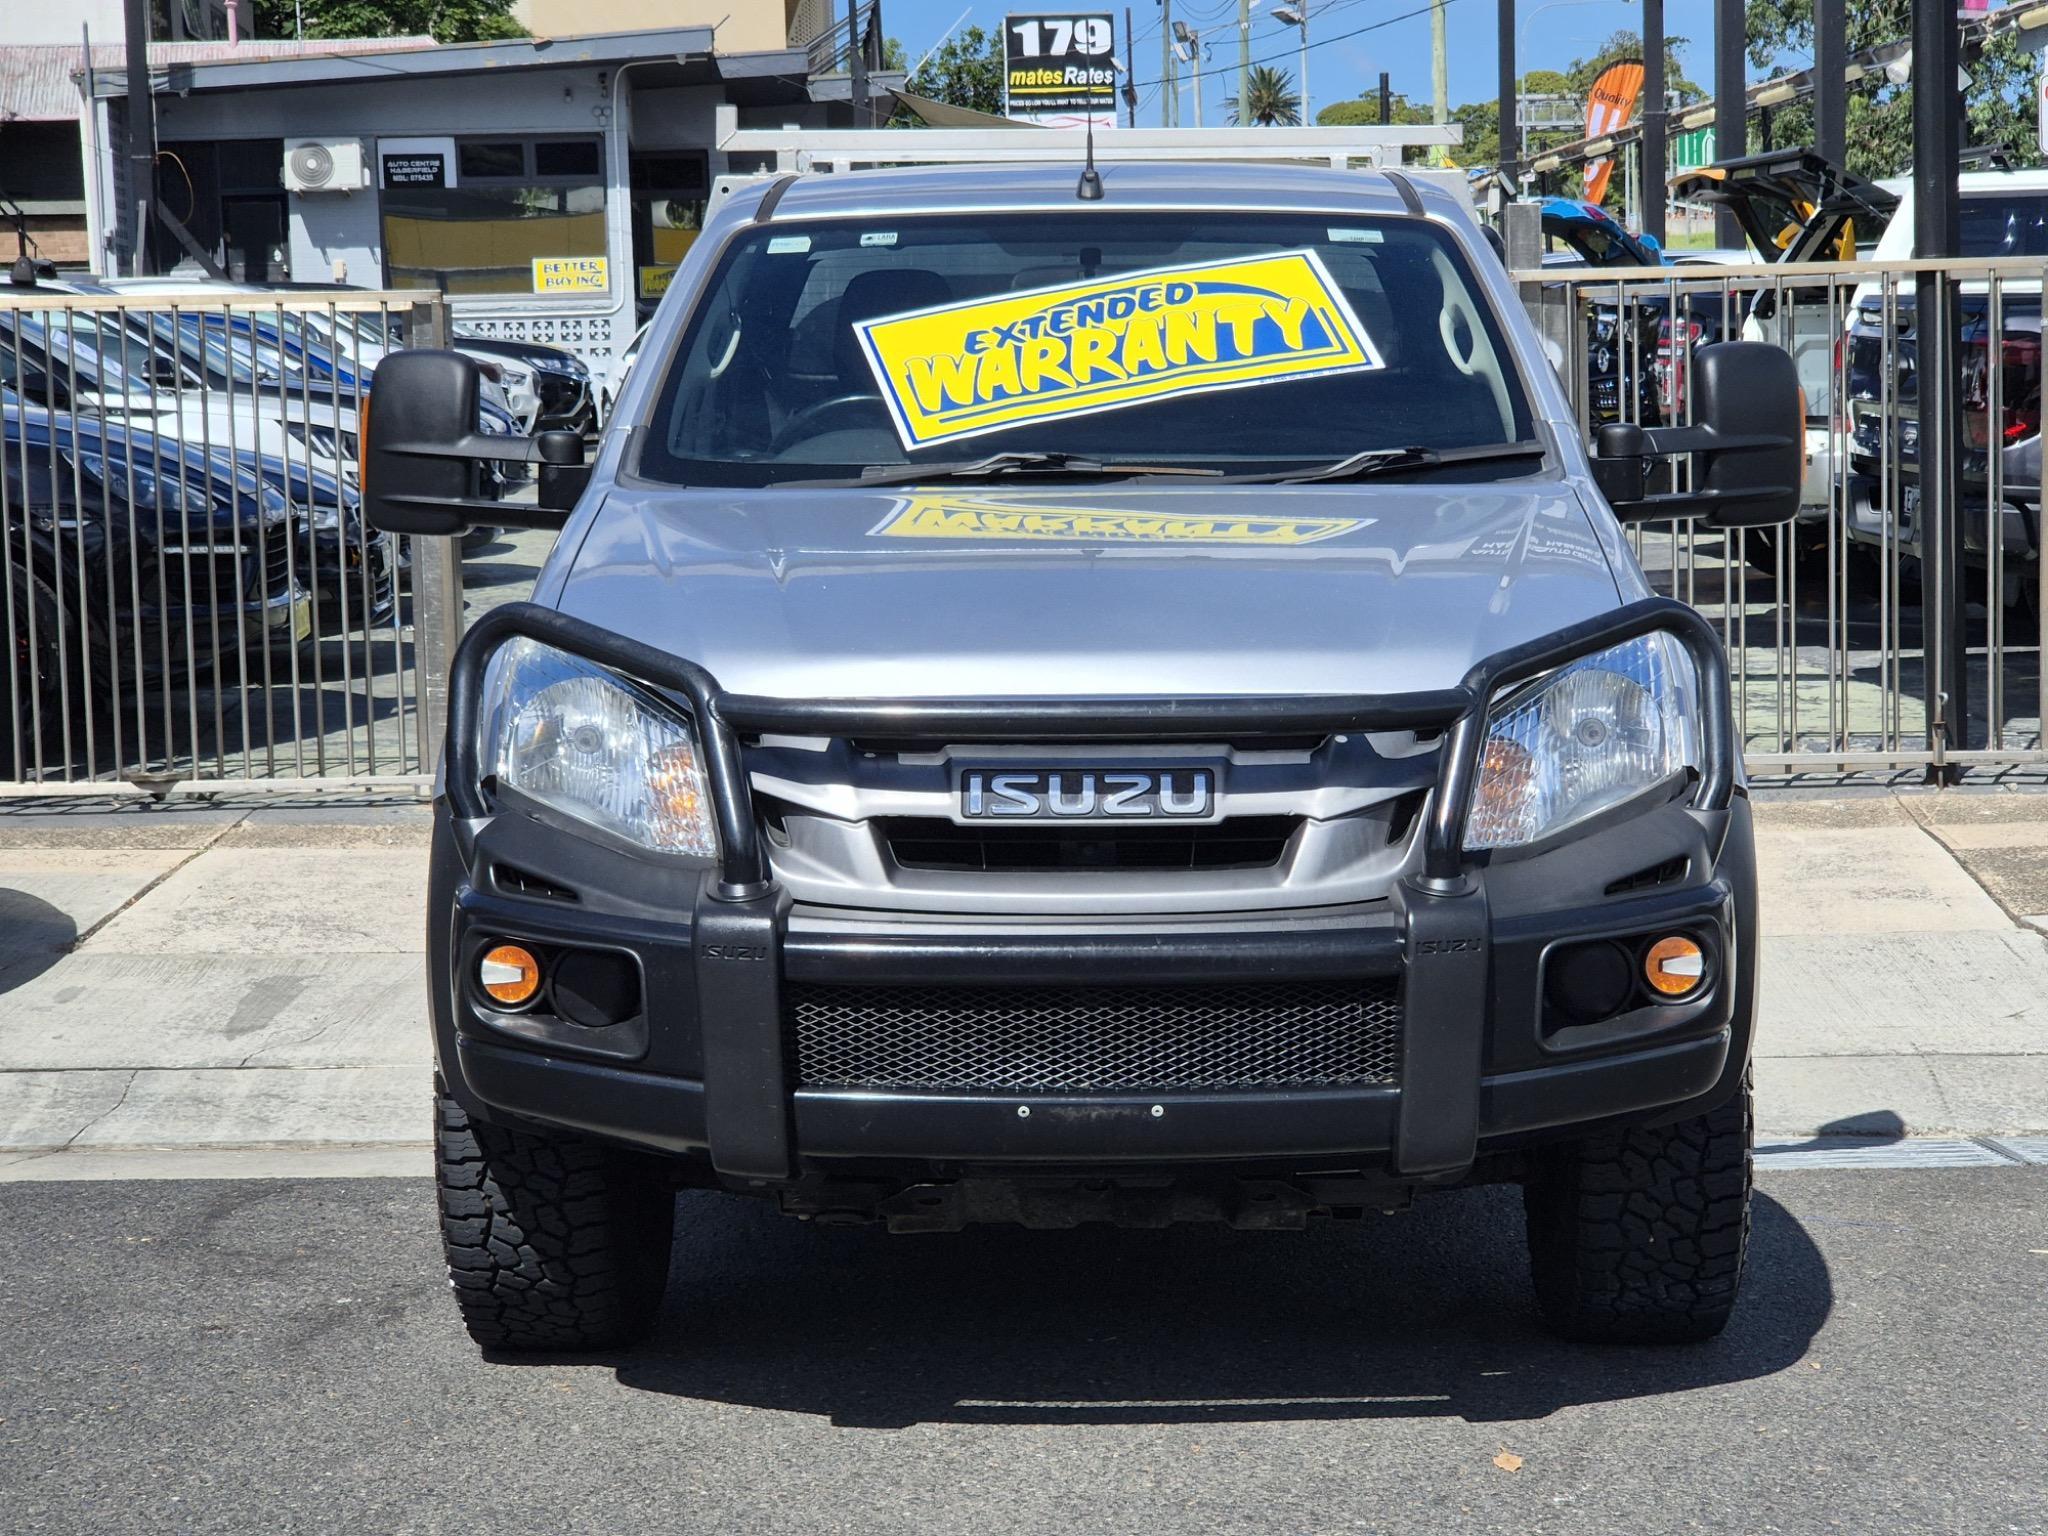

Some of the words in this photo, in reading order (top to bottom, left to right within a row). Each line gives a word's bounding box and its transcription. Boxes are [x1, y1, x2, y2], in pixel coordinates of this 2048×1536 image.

[1012, 18, 1111, 56] 179
[1594, 87, 1632, 107] Quality
[543, 261, 600, 273] BETTER
[546, 275, 601, 288] BUYING
[964, 281, 1195, 355] EXTENDED
[905, 297, 1312, 412] WARRANTY
[969, 774, 1207, 815] ISUZU
[701, 944, 767, 961] ISUZU
